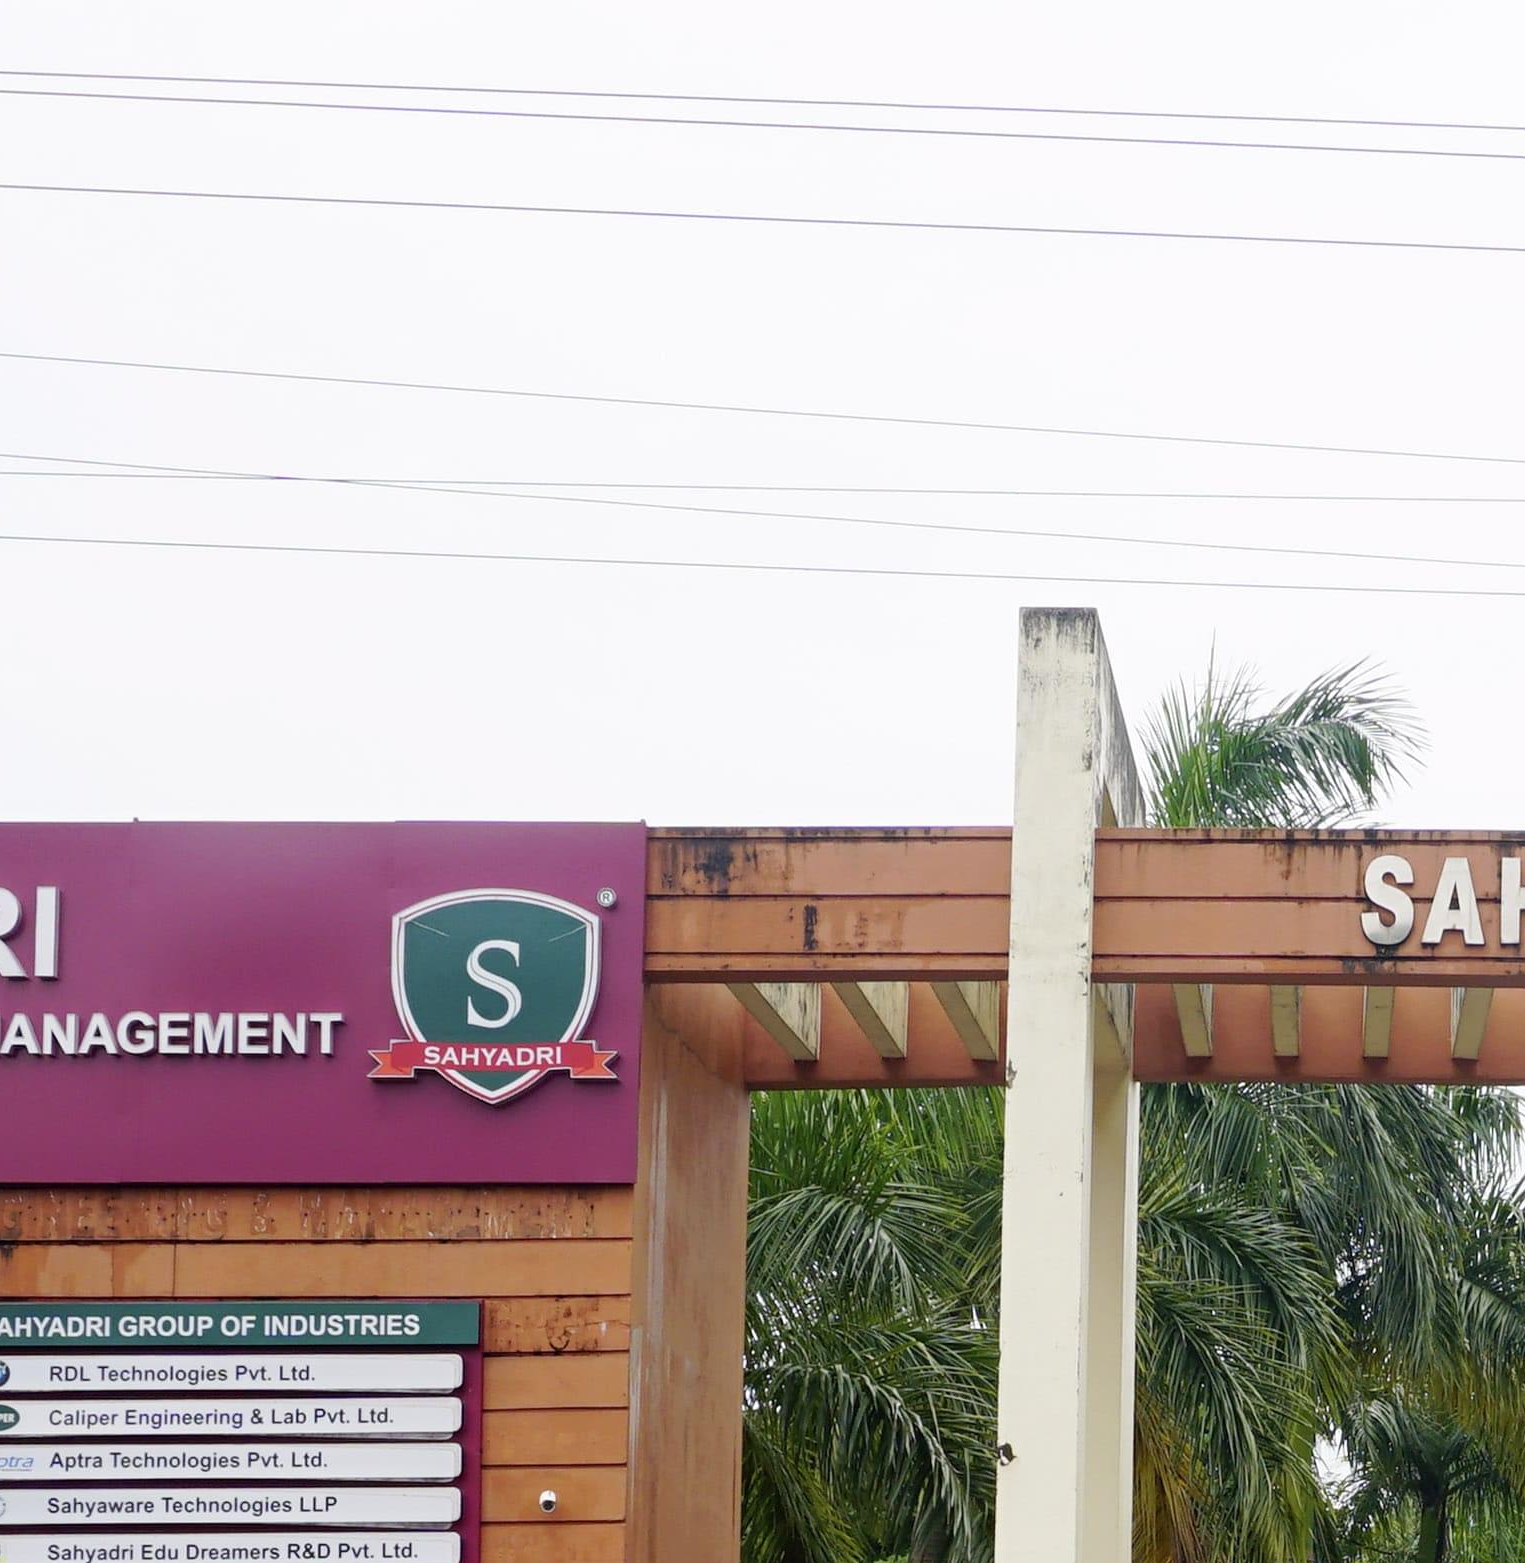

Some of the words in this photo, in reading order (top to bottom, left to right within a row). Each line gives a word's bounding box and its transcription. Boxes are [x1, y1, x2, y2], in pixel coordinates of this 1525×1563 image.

[466, 939, 522, 1029] S
[423, 1043, 562, 1067] SAHYADRI
[118, 1315, 214, 1337] GROUP
[220, 1315, 257, 1337] OF
[264, 1314, 421, 1337] INDUSTRIES
[49, 1365, 91, 1382] RDL
[96, 1365, 228, 1386] Technologies
[235, 1365, 272, 1381] Pvt.
[279, 1365, 315, 1381] Ltd.
[49, 1409, 119, 1430] Caliper
[125, 1408, 243, 1430] Engineering
[250, 1408, 264, 1425] &
[271, 1408, 307, 1425] Lab
[314, 1408, 350, 1424] Pvt.
[357, 1407, 394, 1424] Ltd.
[49, 1452, 103, 1472] Aptra
[109, 1451, 240, 1473] Technologies
[247, 1451, 284, 1468] Pvt.
[291, 1451, 328, 1468] Ltd.
[47, 1497, 155, 1518] Sahyaware
[161, 1496, 292, 1517] Technologies
[299, 1496, 338, 1513] LLP
[141, 1544, 179, 1561] Edu
[186, 1544, 280, 1561] Dreamers
[287, 1542, 331, 1560] R&D
[338, 1542, 374, 1559] Pvt.
[382, 1542, 418, 1559] Ltd.
